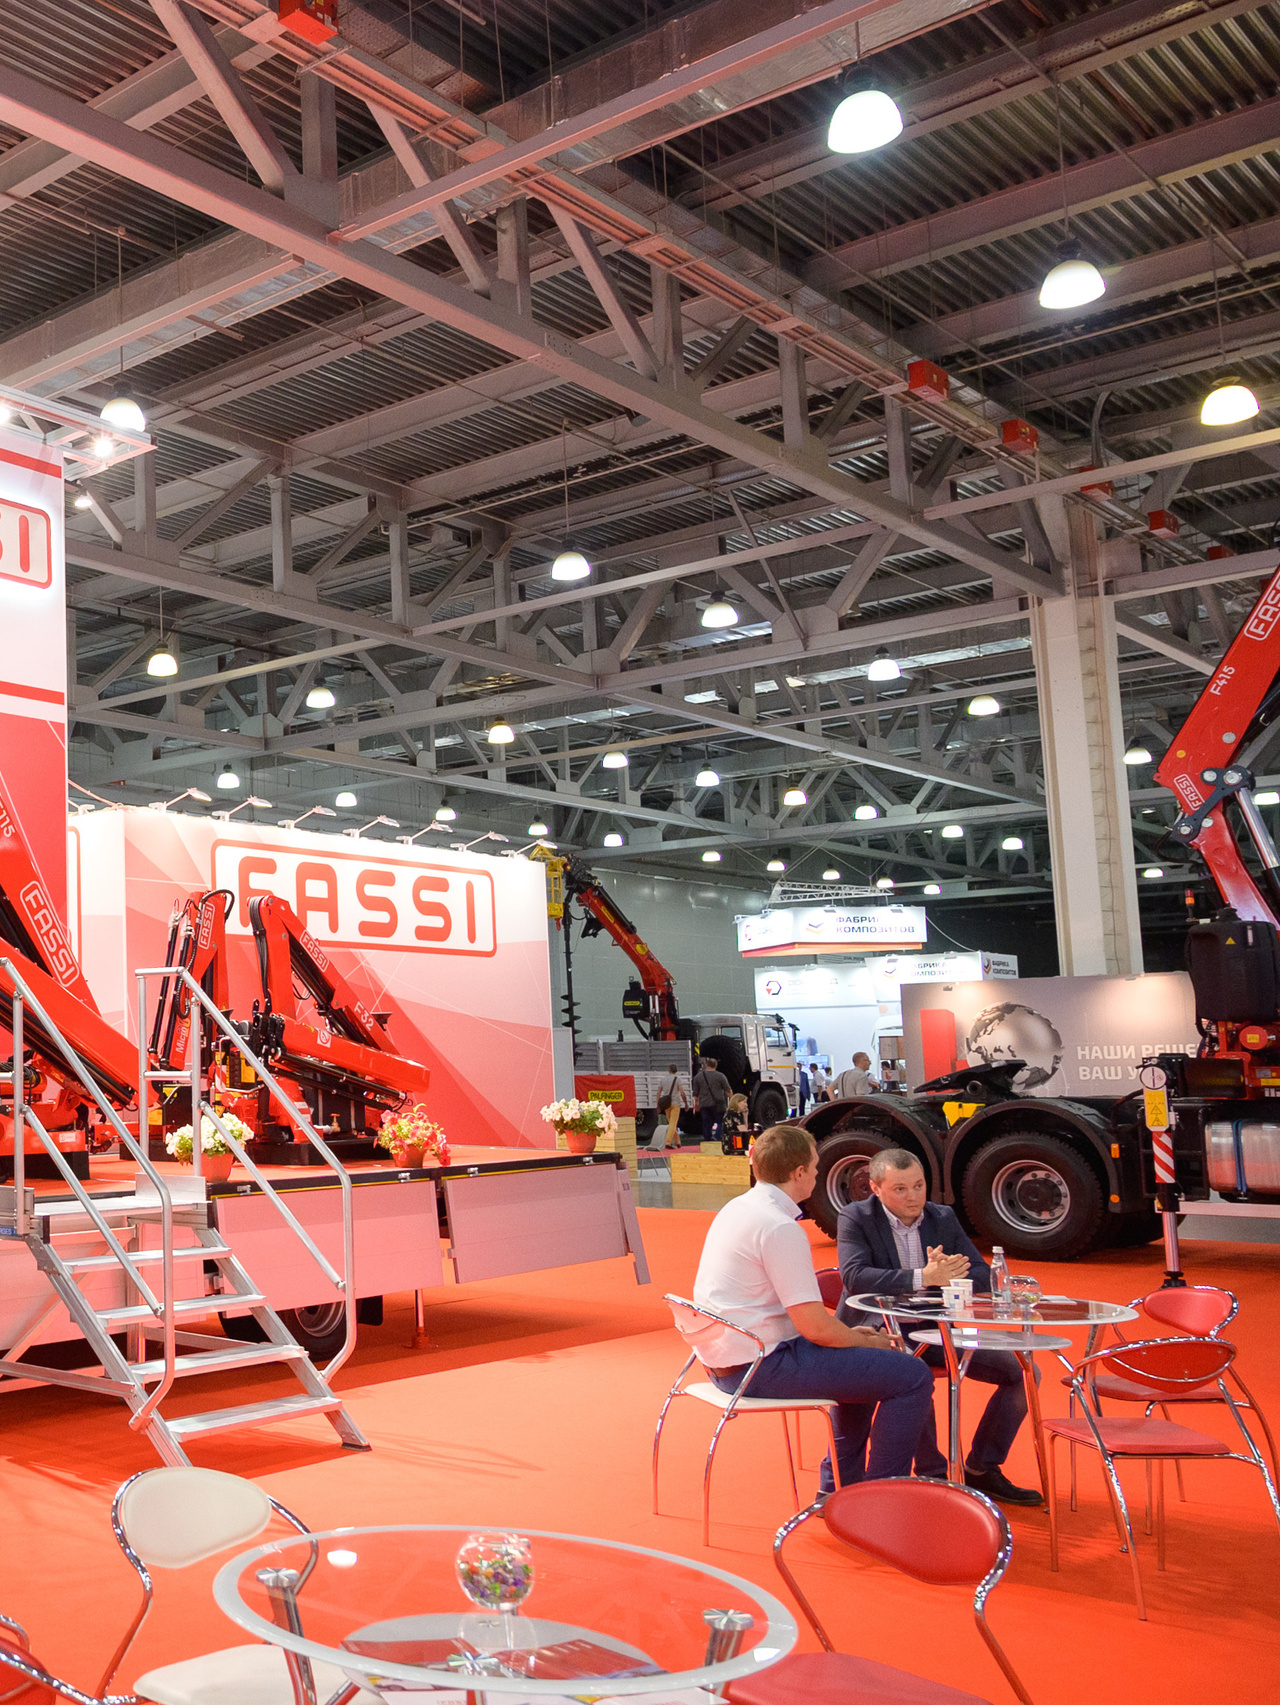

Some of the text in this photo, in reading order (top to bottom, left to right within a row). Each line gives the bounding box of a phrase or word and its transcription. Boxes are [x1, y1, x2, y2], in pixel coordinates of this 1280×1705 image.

[1249, 577, 1280, 635] FAS
[1209, 665, 1236, 696] F415
[1177, 776, 1203, 809] FASSI
[238, 855, 477, 944] FASSI
[24, 886, 76, 987] FASSI
[200, 904, 214, 946] FASSI
[302, 933, 328, 970] FASSI
[353, 1001, 374, 1032] F32
[175, 1026, 188, 1053] Micro
[1077, 1043, 1200, 1060] НАШИ РЕШЕ
[1079, 1066, 1141, 1081] ВАШ У
